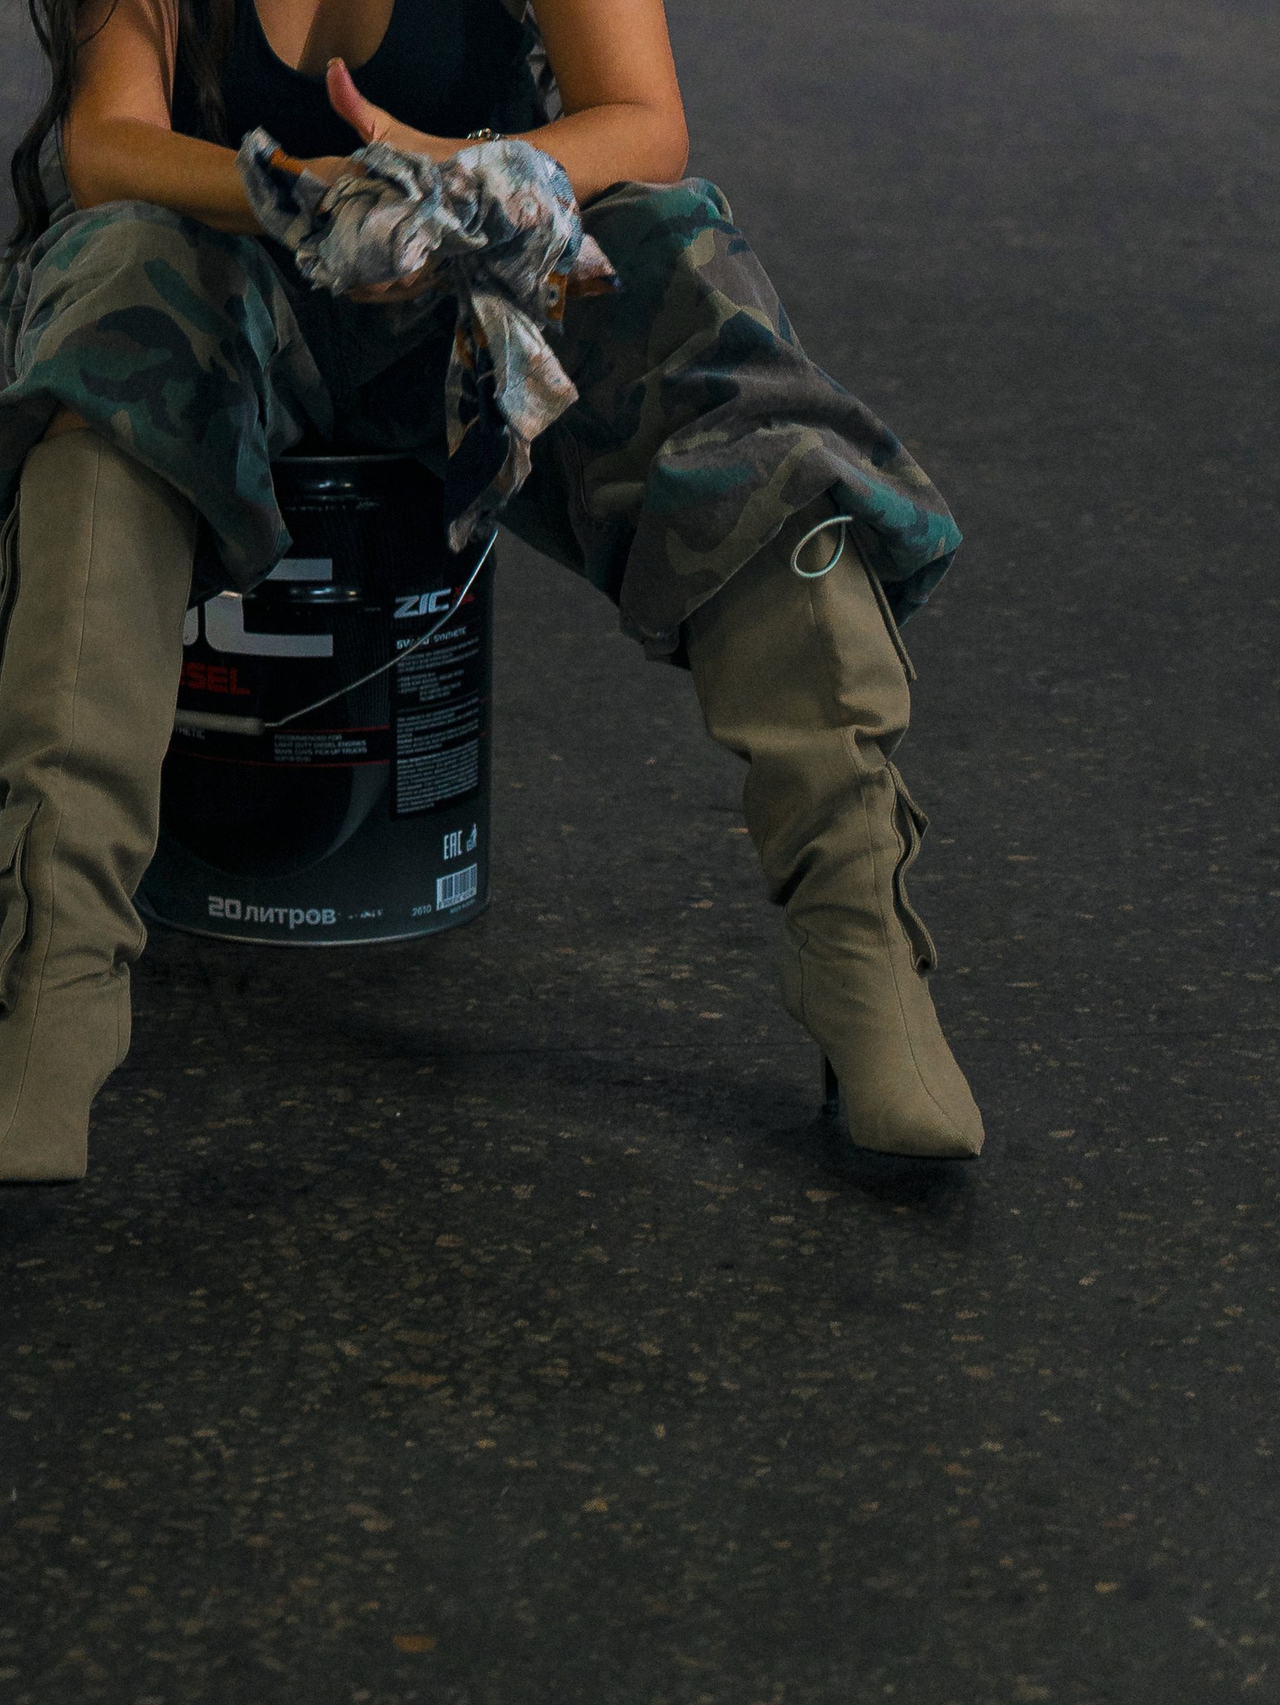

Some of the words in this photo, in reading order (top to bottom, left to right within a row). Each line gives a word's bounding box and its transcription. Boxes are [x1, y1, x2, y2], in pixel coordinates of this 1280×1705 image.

[393, 587, 452, 619] ZIC
[443, 830, 463, 861] EAC
[207, 896, 242, 921] 20
[244, 903, 338, 929] литров
